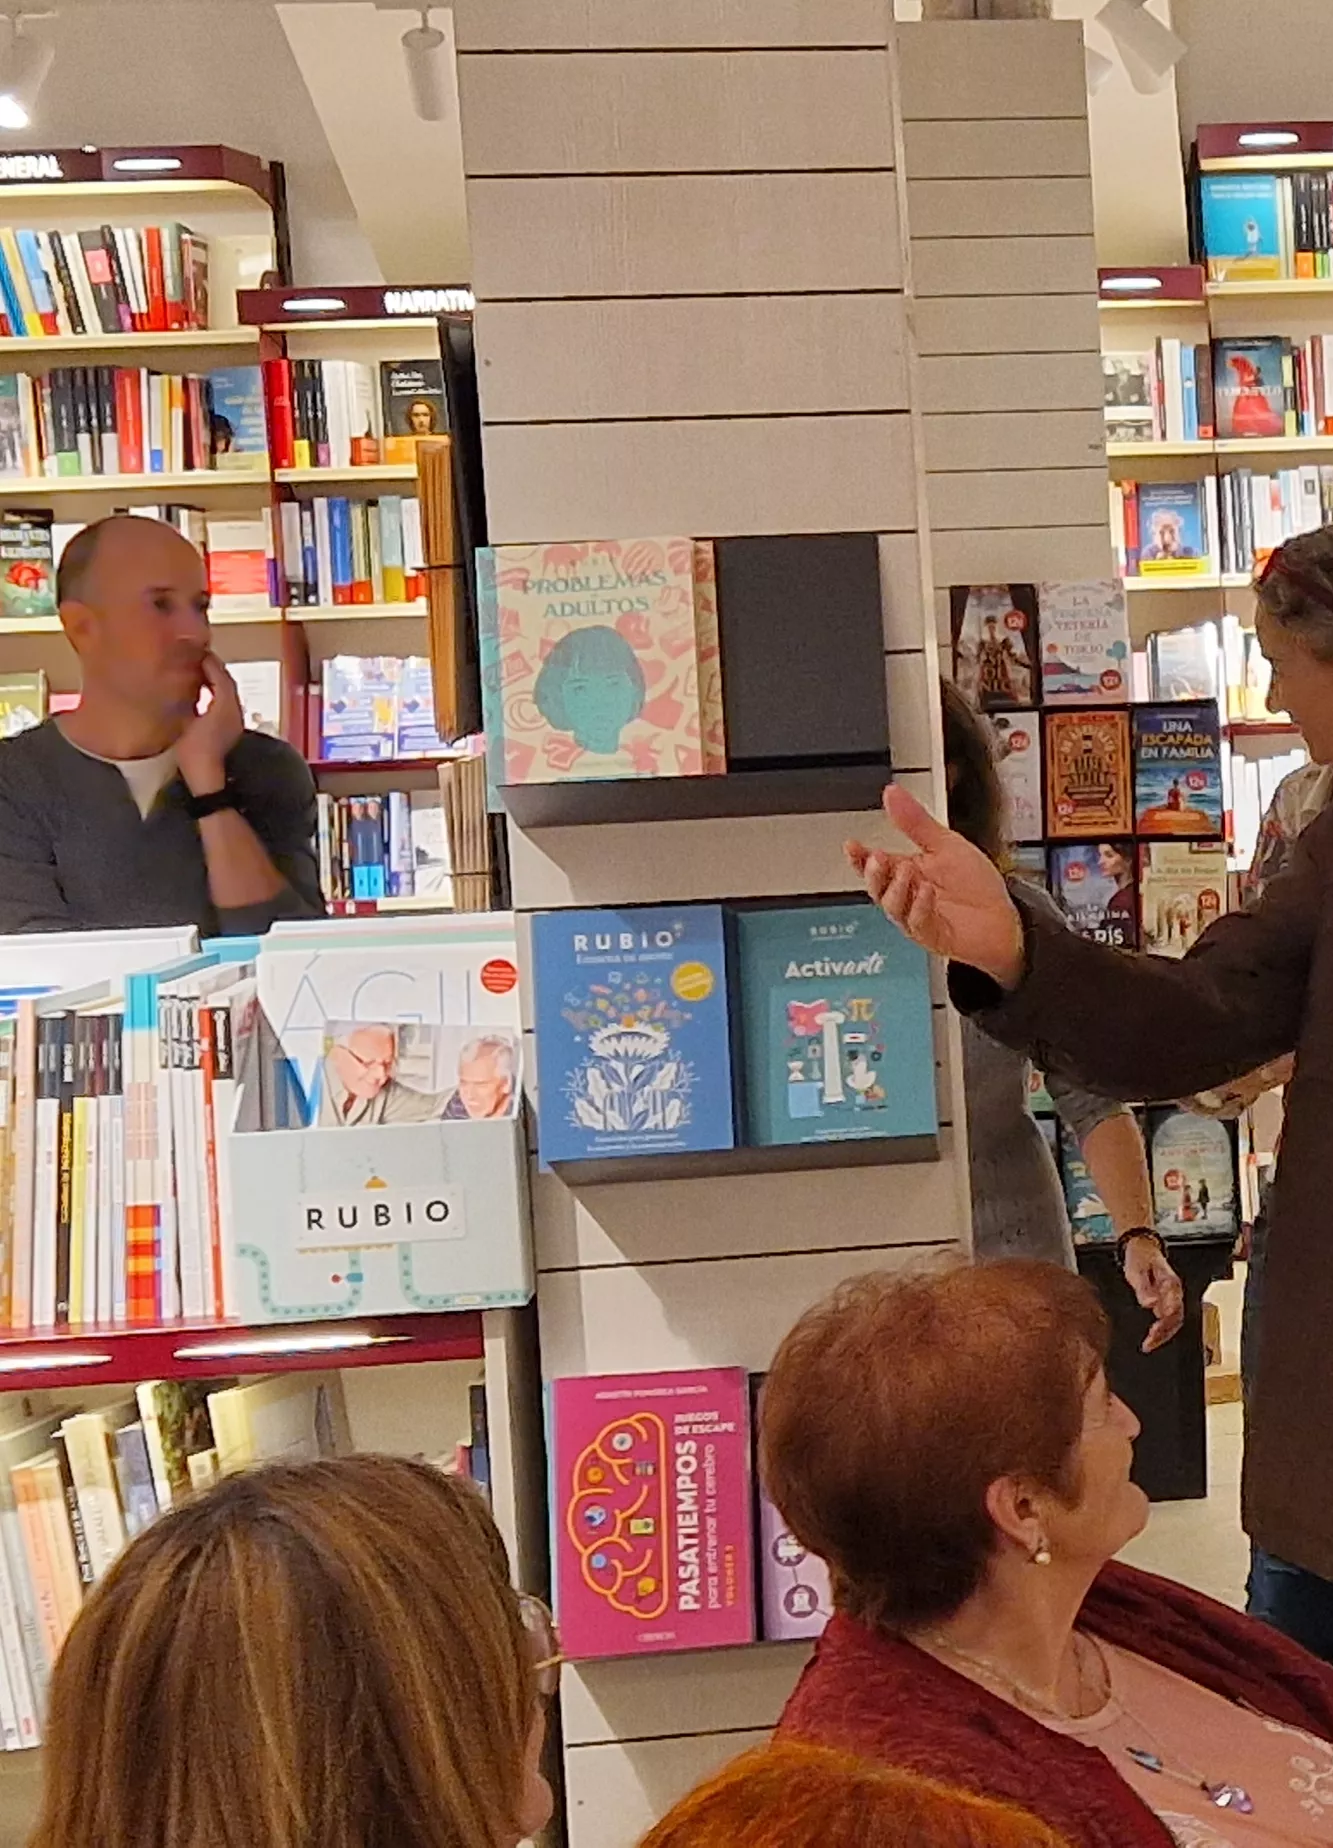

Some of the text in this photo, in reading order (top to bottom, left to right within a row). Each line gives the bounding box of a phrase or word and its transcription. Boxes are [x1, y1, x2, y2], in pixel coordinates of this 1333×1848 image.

[522, 569, 667, 594] PROBLEMAS
[543, 596, 649, 618] ADULTOS
[1162, 721, 1193, 732] UNA
[1141, 734, 1214, 745] ESCAPADA
[1141, 747, 1215, 758] EN FAMILIA
[574, 931, 674, 951] RUBIO
[306, 1200, 450, 1231] RUBIO
[675, 1439, 701, 1612] PASATIEMPOS
[702, 1443, 722, 1610] para entrenar tu cerebro
